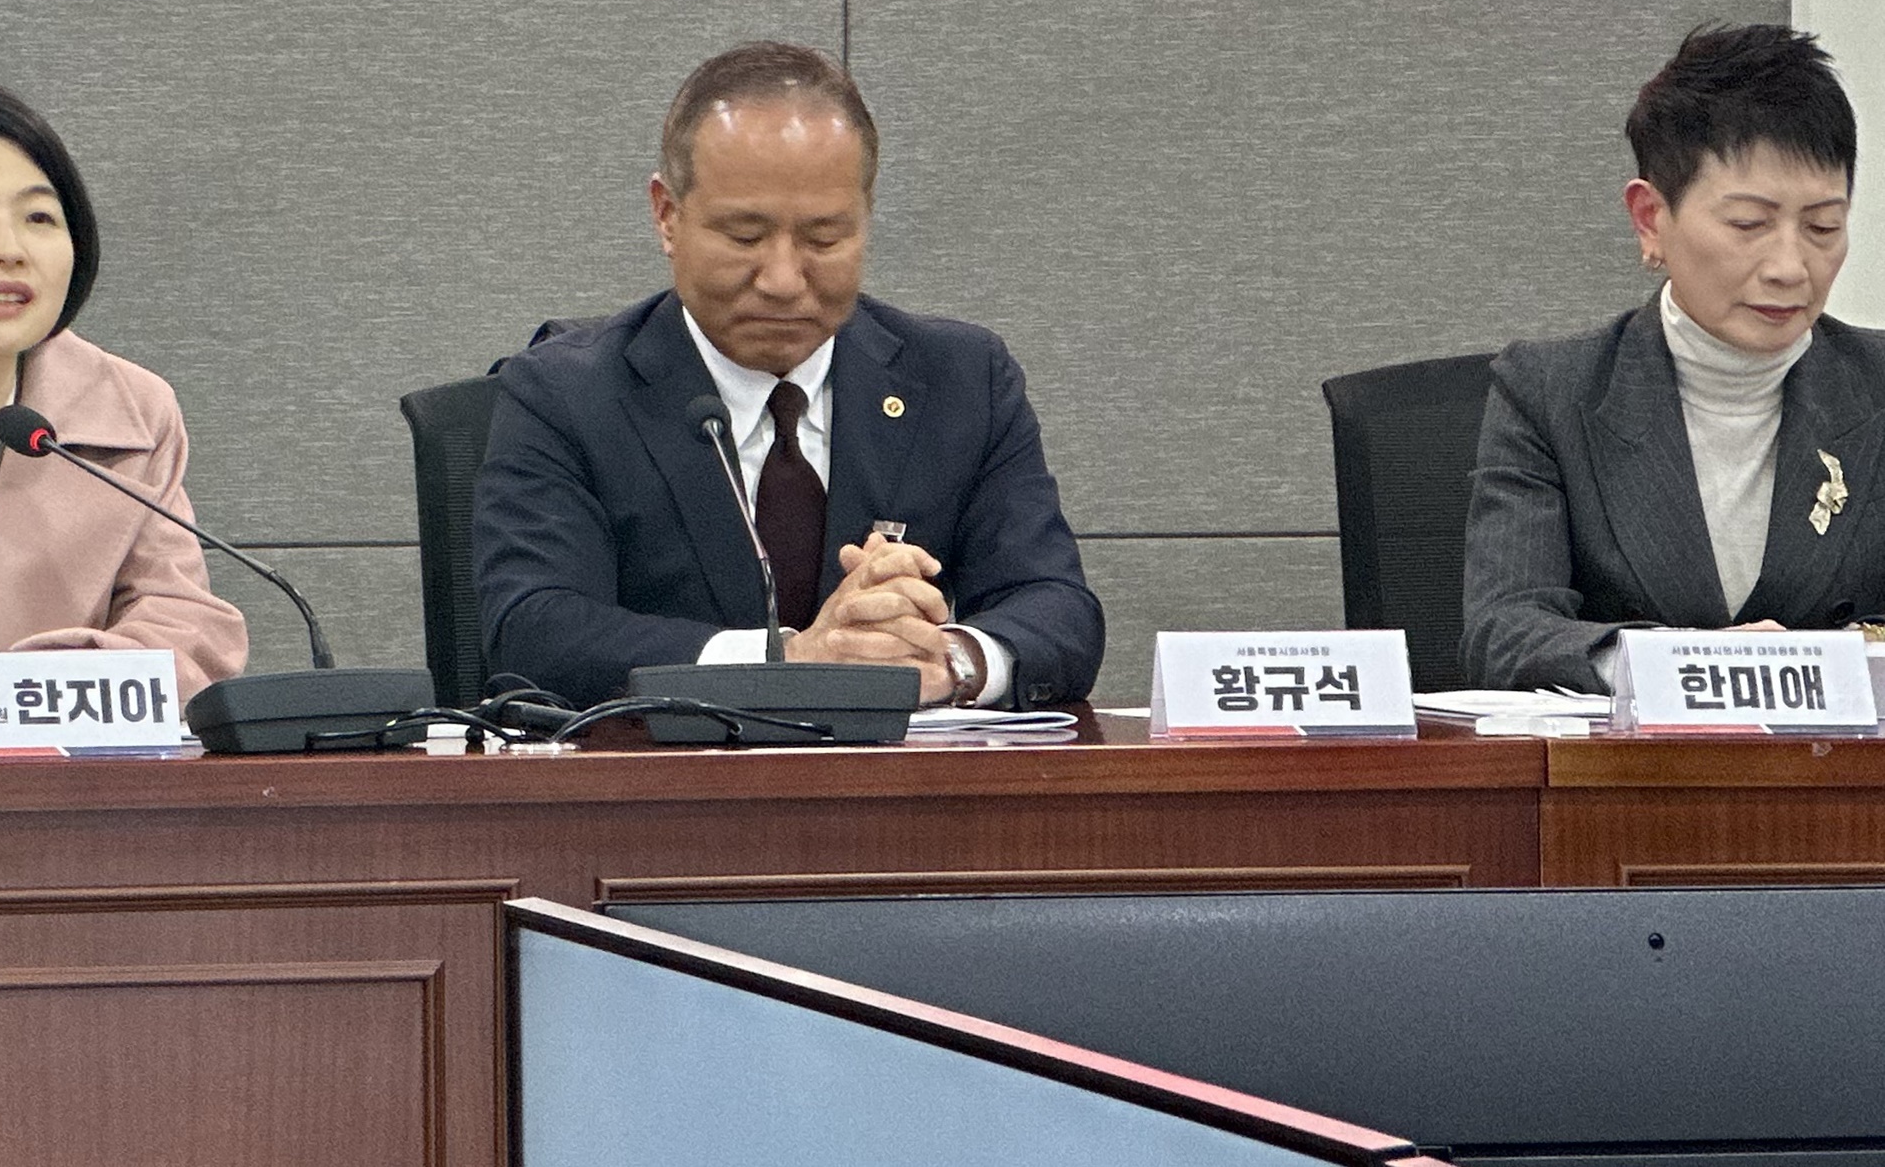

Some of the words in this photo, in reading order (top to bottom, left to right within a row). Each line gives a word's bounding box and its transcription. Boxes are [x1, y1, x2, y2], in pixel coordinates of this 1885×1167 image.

[13, 677, 168, 725] 한지아
[1212, 664, 1362, 712] 황규석
[1677, 663, 1827, 711] 한미애
